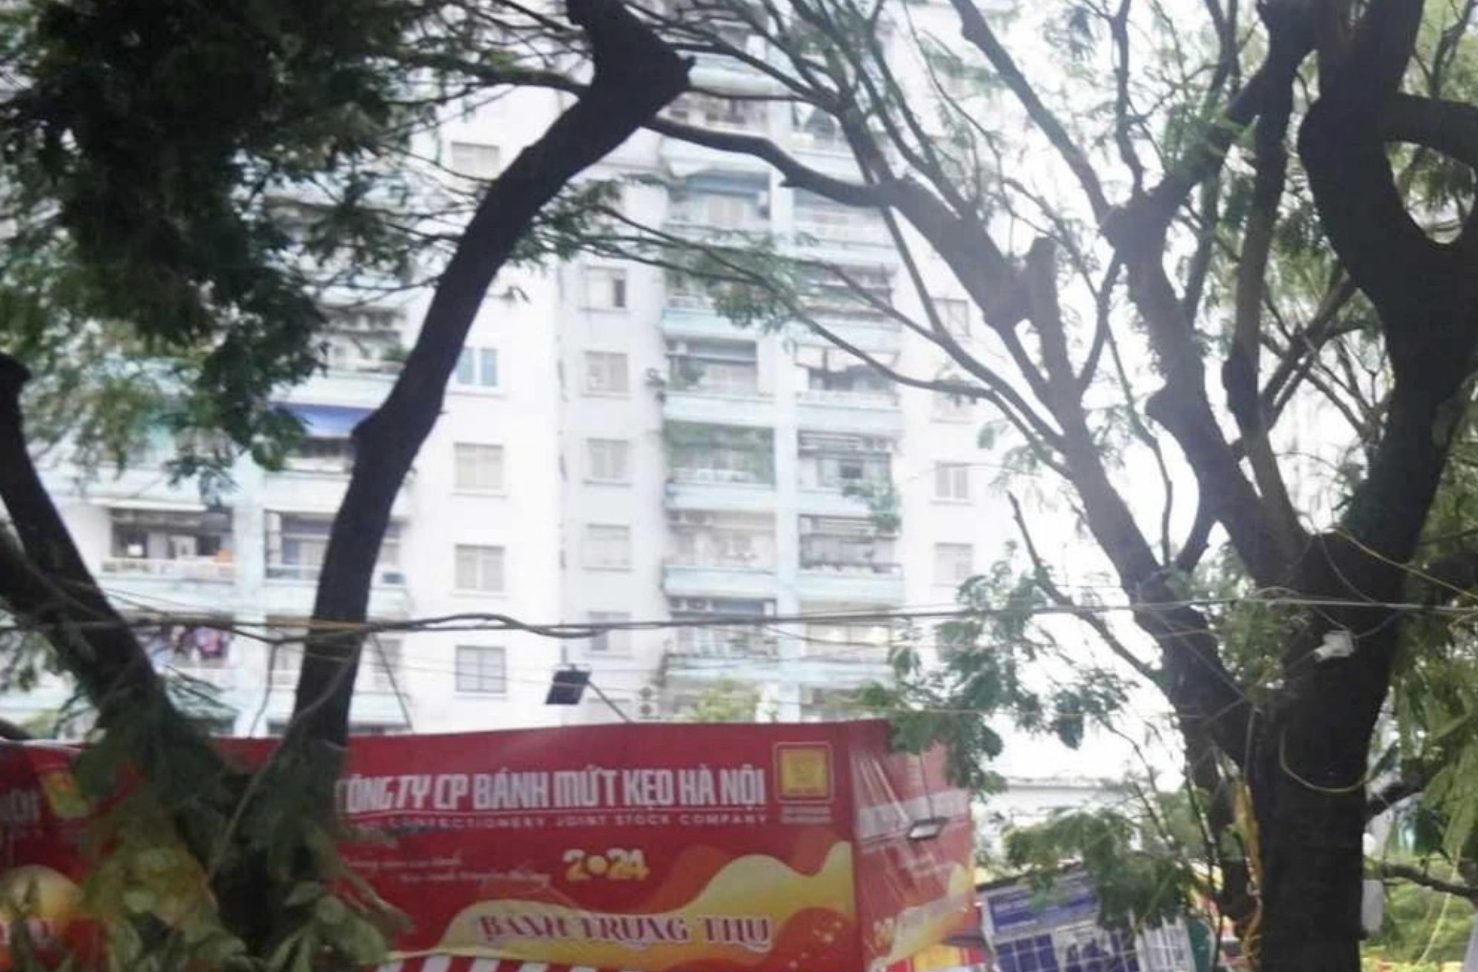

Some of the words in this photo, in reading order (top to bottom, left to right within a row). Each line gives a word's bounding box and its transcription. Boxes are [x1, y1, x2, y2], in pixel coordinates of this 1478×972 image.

[397, 774, 432, 809] TY
[434, 774, 469, 810] CP
[474, 768, 549, 809] BÁNH
[554, 765, 618, 807] MỨT
[623, 769, 674, 811] KẸO
[679, 764, 717, 806] HÀ
[720, 764, 767, 812] NỘI
[615, 813, 671, 826] STOCK
[679, 812, 768, 826] COMPANY
[562, 848, 651, 882] 2024
[580, 913, 689, 943] TRUNG
